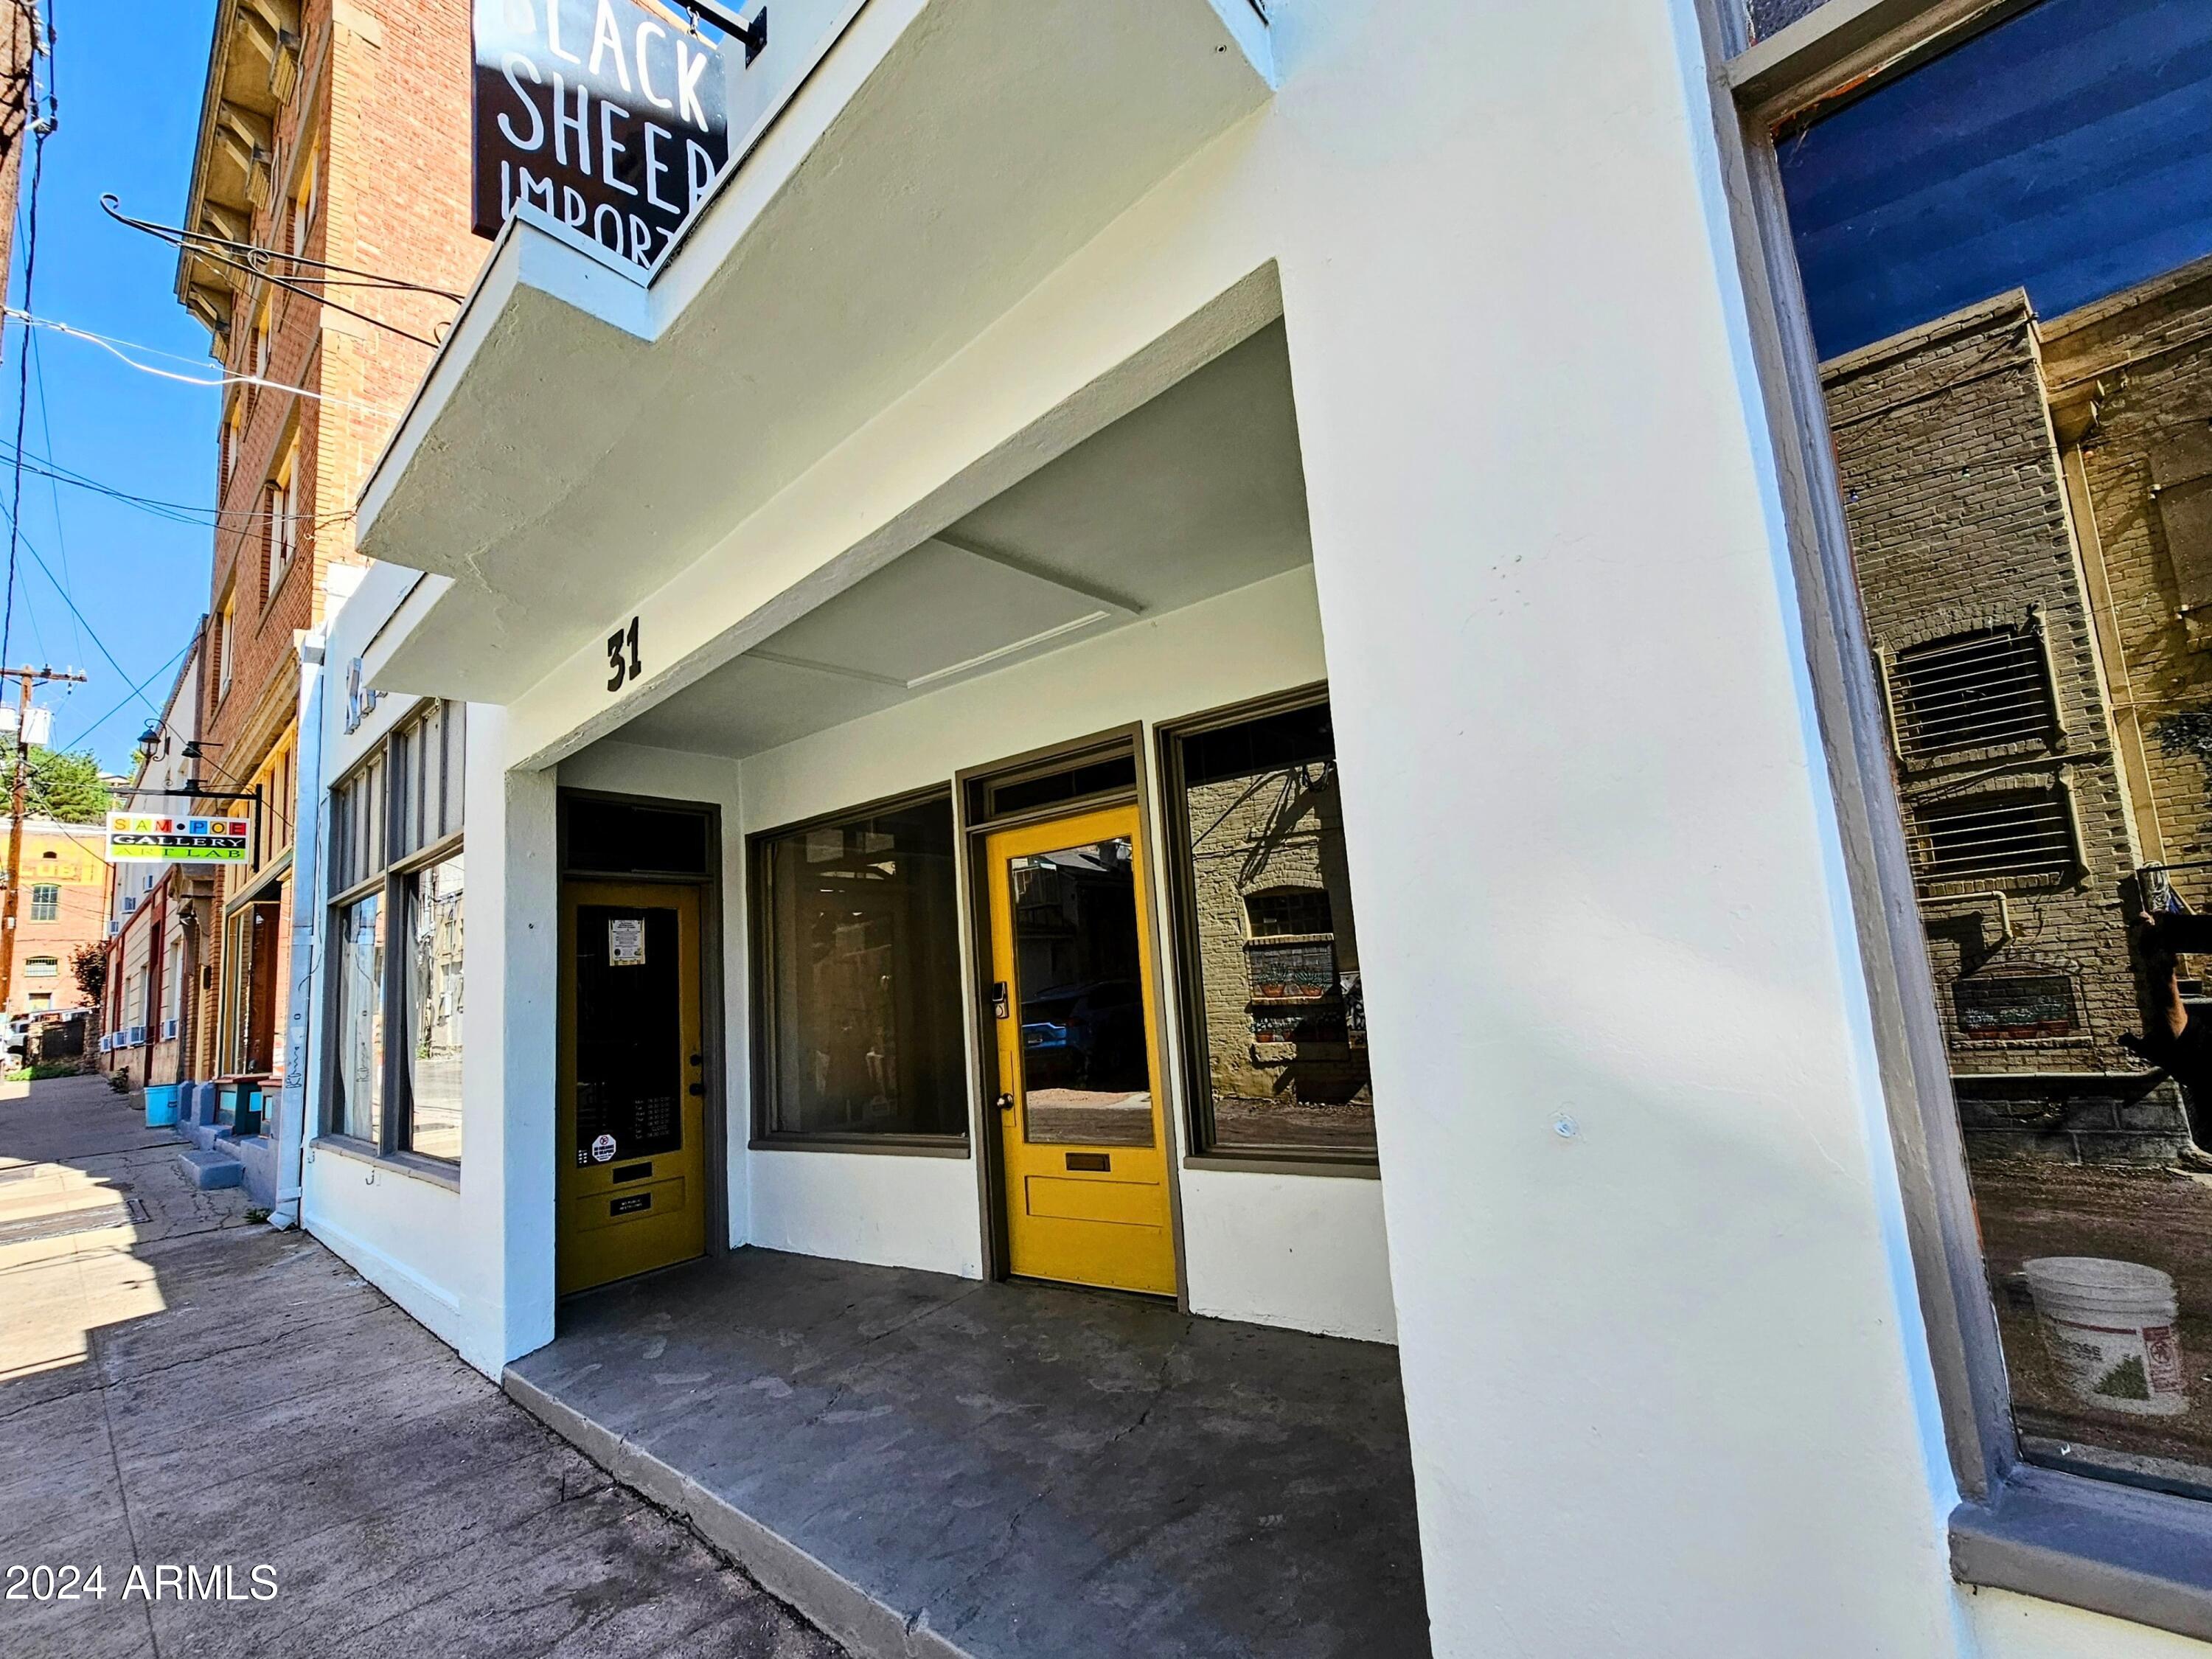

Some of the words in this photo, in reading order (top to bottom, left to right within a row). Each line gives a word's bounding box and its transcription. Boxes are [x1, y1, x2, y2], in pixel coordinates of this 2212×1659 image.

[607, 616, 641, 692] 31
[114, 818, 172, 832] SAM
[190, 821, 246, 835] POE
[114, 835, 243, 847] GALLERY
[116, 847, 175, 856] ART
[187, 849, 241, 858] LAB
